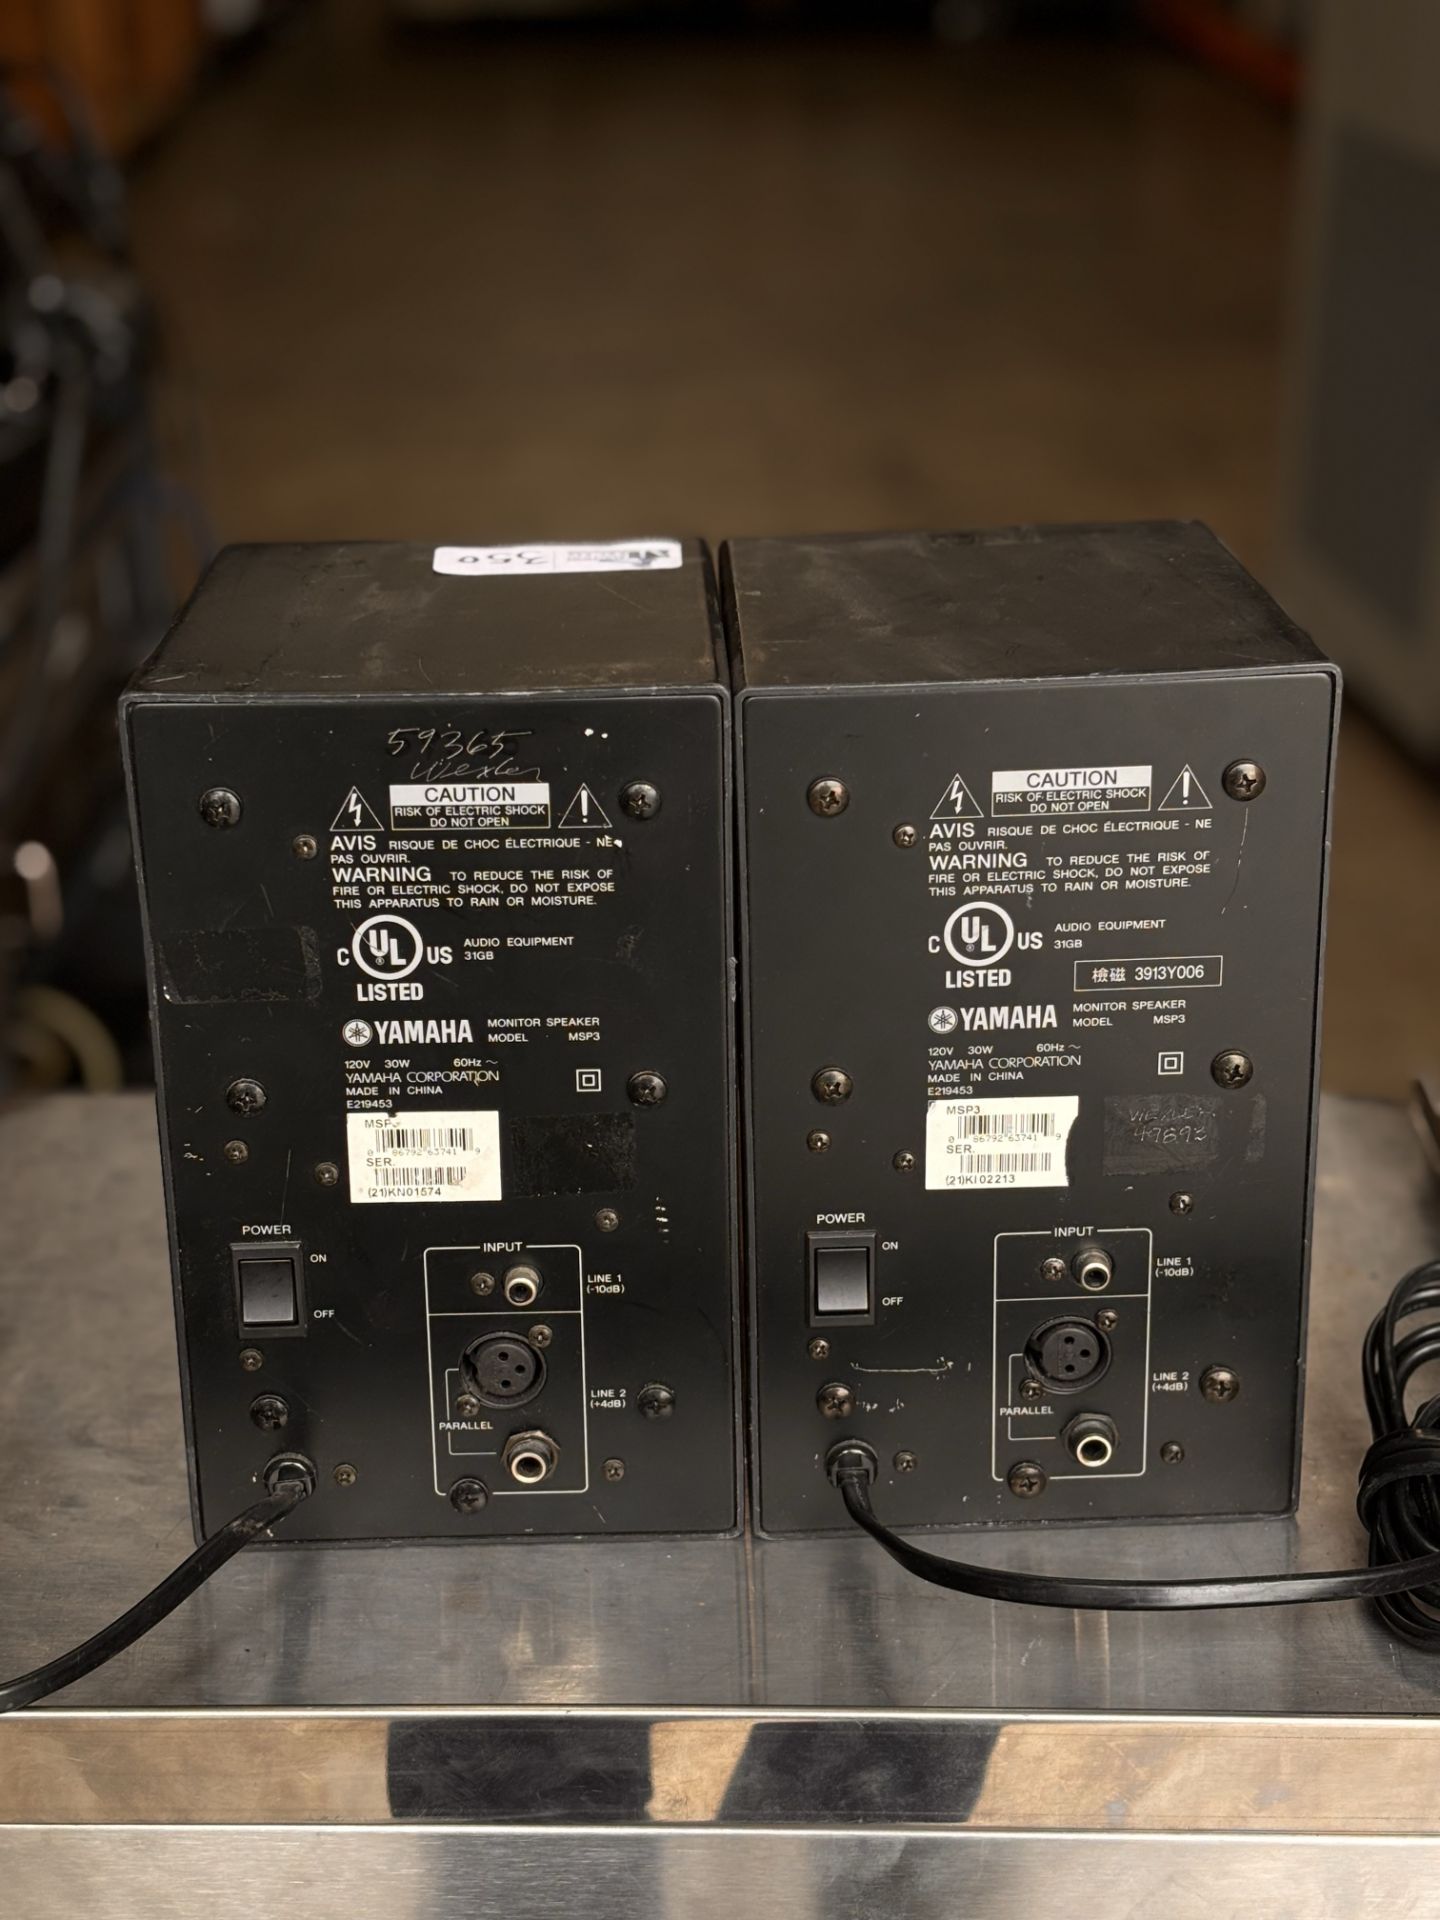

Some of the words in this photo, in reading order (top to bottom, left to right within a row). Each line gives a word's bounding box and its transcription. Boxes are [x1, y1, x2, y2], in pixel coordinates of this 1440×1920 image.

[388, 728, 532, 759] 59365
[1026, 770, 1117, 788] CAUTION
[424, 787, 515, 802] CAUTION
[996, 792, 1022, 802] RISK
[1027, 791, 1041, 801] OF
[1046, 790, 1101, 801] ELECTRIC
[1106, 788, 1146, 799] SHOCK
[395, 806, 421, 816] RISK
[428, 807, 440, 816] OF
[446, 806, 500, 816] ELECTRIC
[506, 805, 546, 814] SHOCK
[1030, 803, 1046, 813] DO
[1051, 802, 1074, 812] NOT
[1078, 801, 1109, 811] OPEN
[430, 818, 446, 828] DO
[451, 818, 474, 827] NOT
[478, 817, 509, 826] OPEN
[930, 822, 974, 839] AVIS
[988, 826, 1032, 837] RISQUE
[1040, 825, 1056, 834] DE
[1063, 823, 1098, 834] CHOC
[1104, 820, 1179, 832] ÉLECTRIQUE
[1196, 819, 1212, 829] NE
[331, 836, 376, 850] AVIS
[389, 840, 434, 850] RISQUE
[442, 840, 458, 849] DE
[464, 839, 499, 849] CHOC
[505, 838, 580, 848] ÉLECTRIQUE
[929, 842, 951, 852] PAS
[958, 840, 1007, 850] OUVRIR.
[331, 855, 353, 864] PAS
[361, 854, 410, 864] OUVRIR.
[930, 853, 1027, 870] WARNING
[1046, 856, 1062, 866] TO
[1070, 854, 1119, 865] REDUCE
[1126, 853, 1150, 863] THE
[1158, 852, 1186, 862] RISK
[1194, 851, 1210, 860] OF
[332, 867, 431, 882] WARNING
[450, 872, 466, 881] TO
[474, 871, 523, 880] REDUCE
[531, 870, 554, 880] THE
[562, 870, 590, 879] RISK
[598, 869, 613, 879] OF
[929, 874, 955, 884] FIRE
[962, 873, 980, 882] OR
[987, 870, 1046, 881] ELECTRIC
[1052, 869, 1098, 879] SHOCK,
[1105, 868, 1123, 877] DO
[1130, 866, 1154, 876] NOT
[1163, 864, 1210, 874] EXPOSE
[333, 886, 360, 896] FIRE
[367, 886, 384, 895] OR
[392, 885, 450, 894] ELECTRIC
[458, 884, 504, 894] SHOCK,
[510, 884, 528, 893] DO
[536, 884, 559, 893] NOT
[568, 882, 615, 892] EXPOSE
[929, 886, 956, 896] THIS
[963, 884, 1034, 895] APPARATUS
[1040, 883, 1058, 892] TO
[1065, 881, 1093, 892] RAIN
[1101, 880, 1118, 890] OR
[1126, 878, 1190, 889] MOISTURE.
[336, 900, 361, 909] THIS
[369, 898, 440, 908] APPARATUS
[446, 898, 463, 907] TO
[470, 898, 499, 906] RAIN
[506, 897, 524, 906] OR
[531, 896, 597, 906] MOISTURE.
[1054, 922, 1091, 932] AUDIO
[1098, 920, 1166, 930] EQUIPMENT
[929, 936, 940, 953] C
[961, 916, 996, 952] UL
[1017, 932, 1043, 950] US
[337, 948, 349, 966] C
[369, 930, 406, 966] UL
[427, 946, 452, 964] US
[464, 938, 500, 948] AUDIO
[507, 937, 574, 946] EQUIPMENT
[1054, 939, 1082, 949] 31GB
[464, 952, 494, 960] 31GB
[946, 969, 1011, 988] LISTED
[1135, 965, 1204, 981] 3913Y006
[357, 983, 423, 1001] LISTED
[1073, 1002, 1126, 1012] MONITOR
[1132, 1000, 1186, 1010] SPEAKER
[488, 1018, 540, 1028] MONITOR
[546, 1018, 599, 1027] SPEAKER
[960, 1005, 1057, 1030] YAMAHA
[1072, 1017, 1112, 1027] MODEL
[1153, 1014, 1186, 1024] MSP3
[374, 1020, 473, 1044] YAMAHA
[488, 1033, 528, 1042] MODEL
[569, 1032, 600, 1041] MSP3
[928, 1047, 953, 1056] 120V
[968, 1046, 993, 1054] 30W
[1037, 1043, 1064, 1052] 60Hz
[344, 1060, 370, 1069] 120V
[384, 1059, 410, 1068] 30W
[454, 1058, 481, 1068] 60Hz
[928, 1059, 984, 1070] YAMAHA
[989, 1055, 1081, 1068] CORPORATION
[346, 1072, 402, 1084] YAMAHA
[407, 1070, 499, 1082] CORPORATION
[928, 1073, 960, 1083] MADE
[970, 1072, 981, 1081] IN
[988, 1072, 1023, 1081] CHINA
[346, 1087, 378, 1096] MADE
[389, 1086, 400, 1095] IN
[407, 1086, 442, 1095] CHINA
[928, 1086, 973, 1095] E219453
[347, 1100, 392, 1109] E219453
[947, 1105, 980, 1115] MSP3
[1056, 1133, 1062, 1141] 9
[946, 1144, 976, 1154] SER.
[367, 1158, 395, 1167] SER.
[368, 1188, 441, 1197] (21)KN01574
[817, 1213, 865, 1224] POWER
[242, 1225, 291, 1236] POWER
[1054, 1226, 1094, 1237] INPUT
[484, 1242, 522, 1252] INPUT
[1156, 1257, 1181, 1266] LINE
[1155, 1267, 1194, 1277] (-10dB)
[587, 1275, 610, 1283] LINE
[617, 1274, 621, 1282] 1
[586, 1284, 625, 1294] (-10dB)
[882, 1298, 903, 1306] OFF
[314, 1310, 335, 1318] OFF
[1153, 1372, 1177, 1381] LINE
[1152, 1382, 1188, 1392] (+4dB)
[590, 1399, 626, 1408] (+4dB)
[1000, 1406, 1054, 1416] PARALLEL
[439, 1421, 493, 1431] PARALLEL
